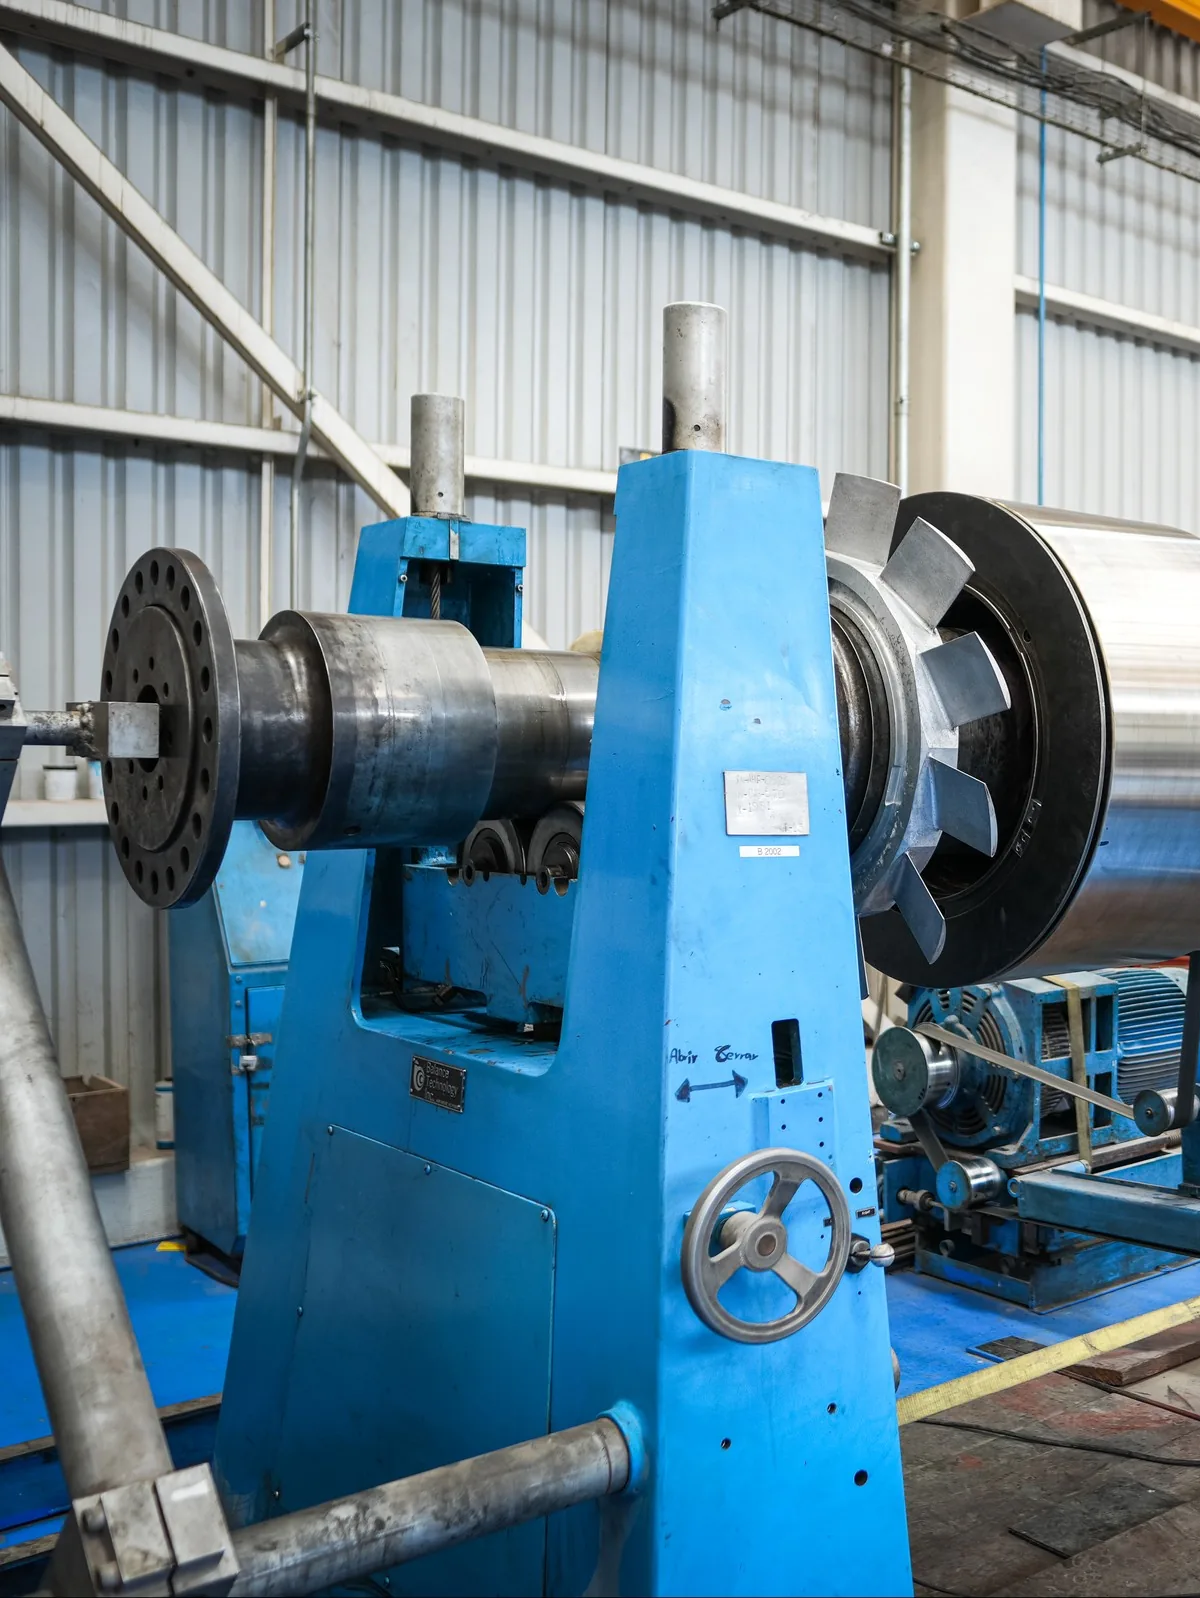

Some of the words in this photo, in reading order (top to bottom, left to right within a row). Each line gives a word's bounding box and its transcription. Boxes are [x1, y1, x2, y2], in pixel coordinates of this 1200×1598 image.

[757, 847, 763, 856] B
[765, 847, 782, 856] 2002
[669, 1047, 698, 1065] Abrir
[426, 1061, 450, 1079] Balance
[426, 1074, 459, 1098] Technology
